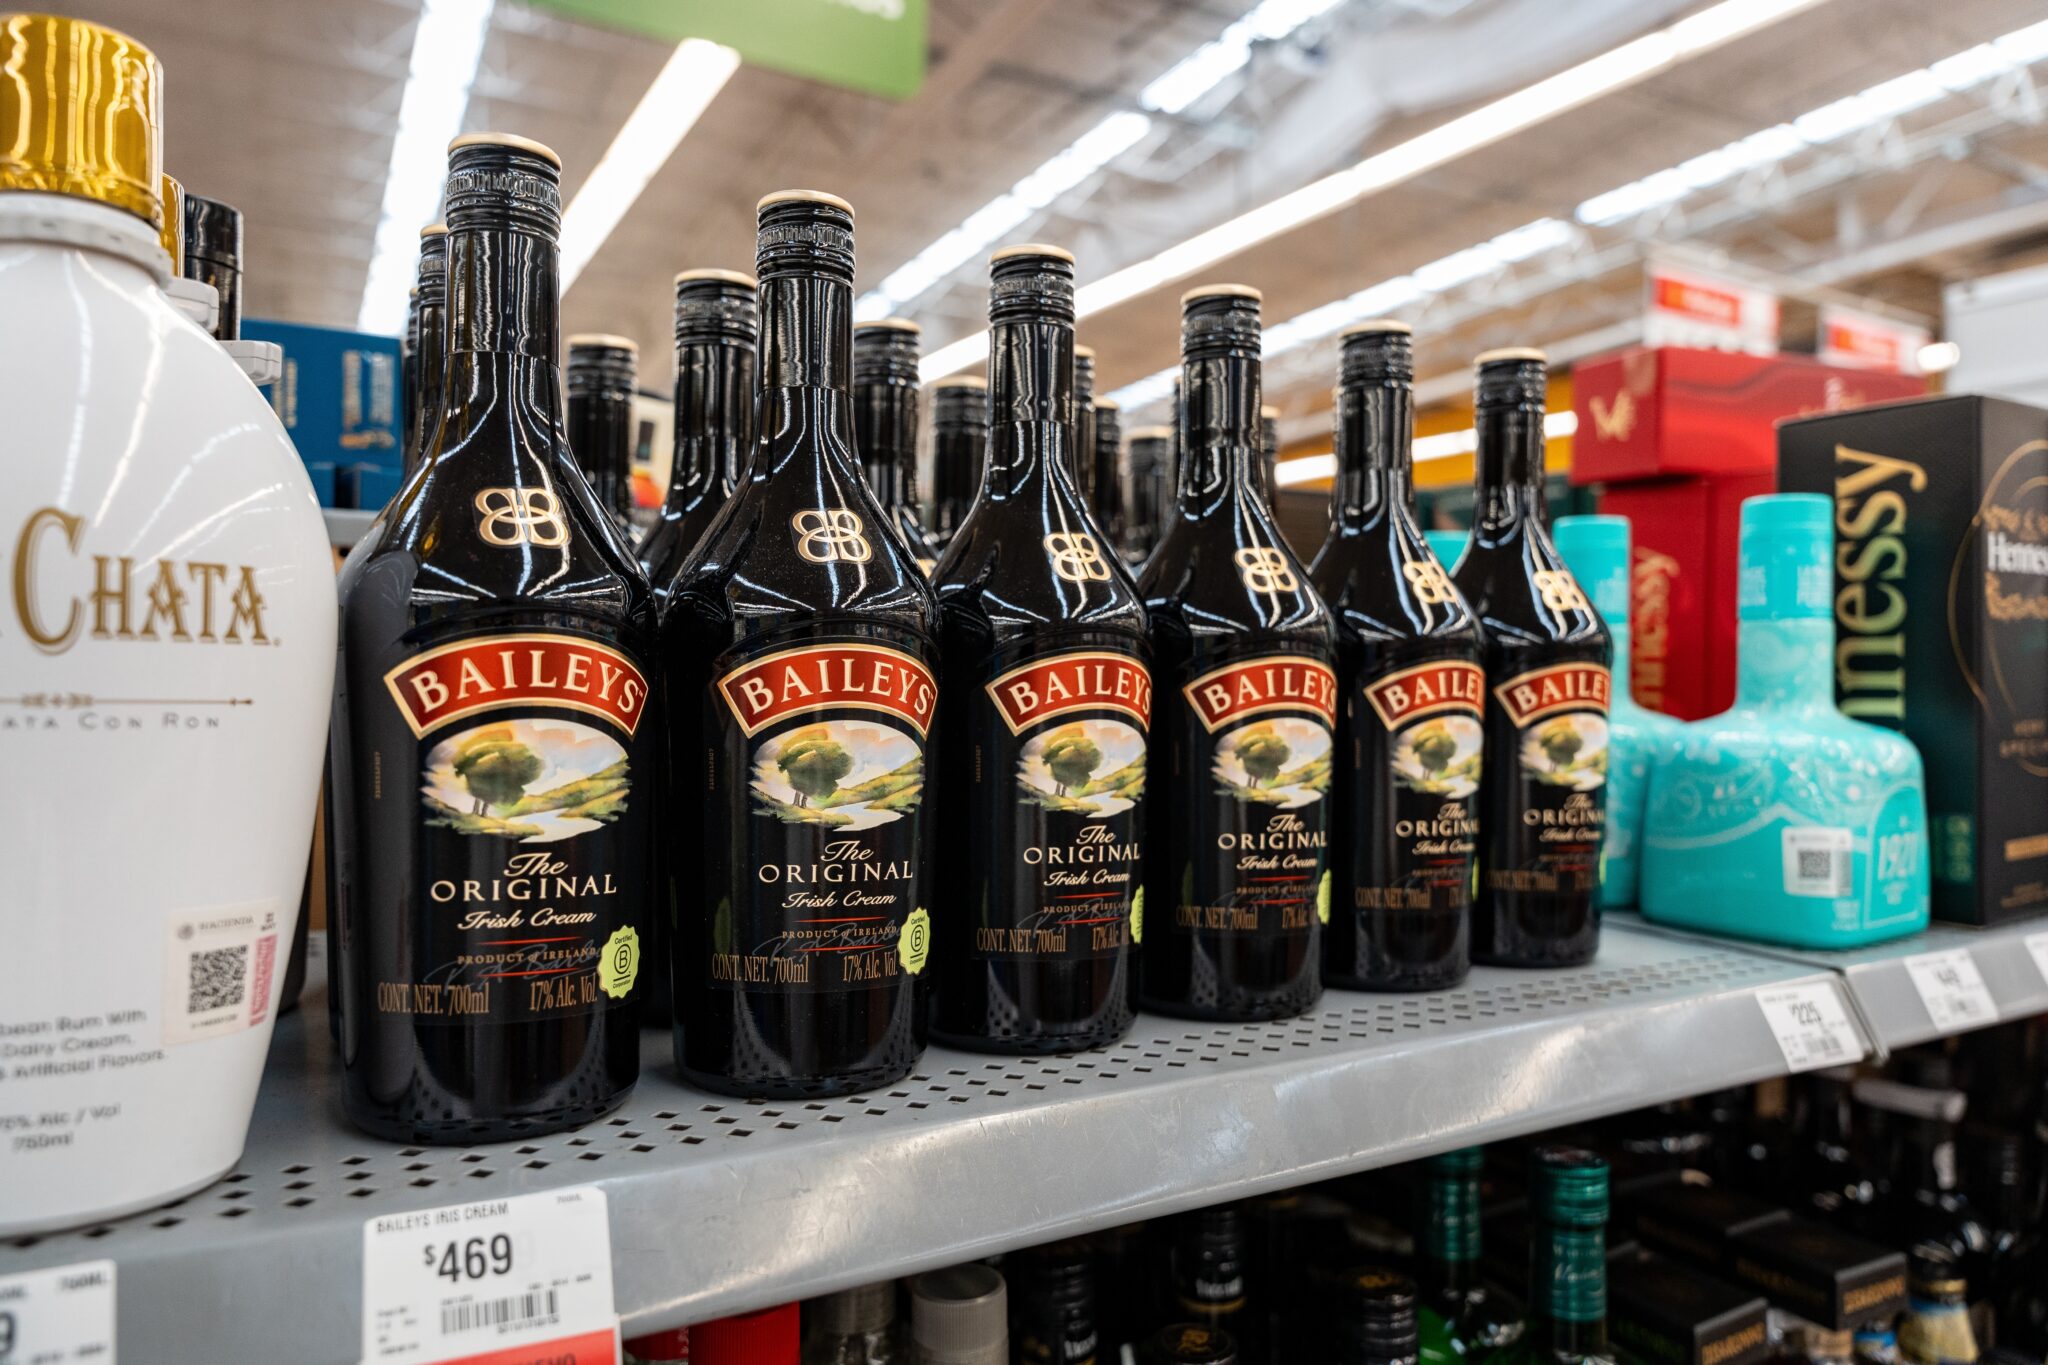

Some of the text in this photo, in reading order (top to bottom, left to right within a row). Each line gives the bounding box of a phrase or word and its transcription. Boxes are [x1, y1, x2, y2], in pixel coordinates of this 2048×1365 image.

[410, 651, 640, 713] BAILEYS
[740, 658, 931, 716] BAILEYS
[1008, 665, 1151, 715] BAILEYS
[1266, 813, 1305, 832] The
[1076, 825, 1116, 845] The
[1218, 831, 1328, 850] ORIGINAL
[820, 840, 875, 862] The
[1023, 843, 1140, 865] ORIGINAL
[503, 852, 568, 877] The
[759, 860, 914, 883] ORIGINAL
[1236, 855, 1279, 870] Irish
[430, 874, 617, 902] ORIGINAL
[1043, 868, 1130, 886] Irish Cream
[781, 890, 898, 908] Irish Cream
[1043, 904, 1089, 913] PRODUCT
[457, 907, 597, 930] Irish Cream
[615, 934, 633, 945] Certified
[782, 929, 838, 939] PRODUCT
[854, 926, 898, 937] IRELAND
[977, 928, 1007, 952] CONT.
[1009, 929, 1033, 952] NET.
[1036, 928, 1066, 954] 700ml
[457, 952, 524, 965] PRODUCT
[543, 946, 597, 960] IRELAND
[712, 953, 741, 980] CONT.
[744, 955, 769, 982] NET.
[773, 954, 809, 984] 700ml
[843, 954, 863, 982] 17%
[863, 952, 882, 979] Alc.
[378, 971, 598, 1016] CONT. NET. 700ml 17% Alc. Vol.
[376, 1213, 430, 1234] BAILEYS
[436, 1208, 460, 1225] IRIS
[465, 1202, 509, 1221] CREAM
